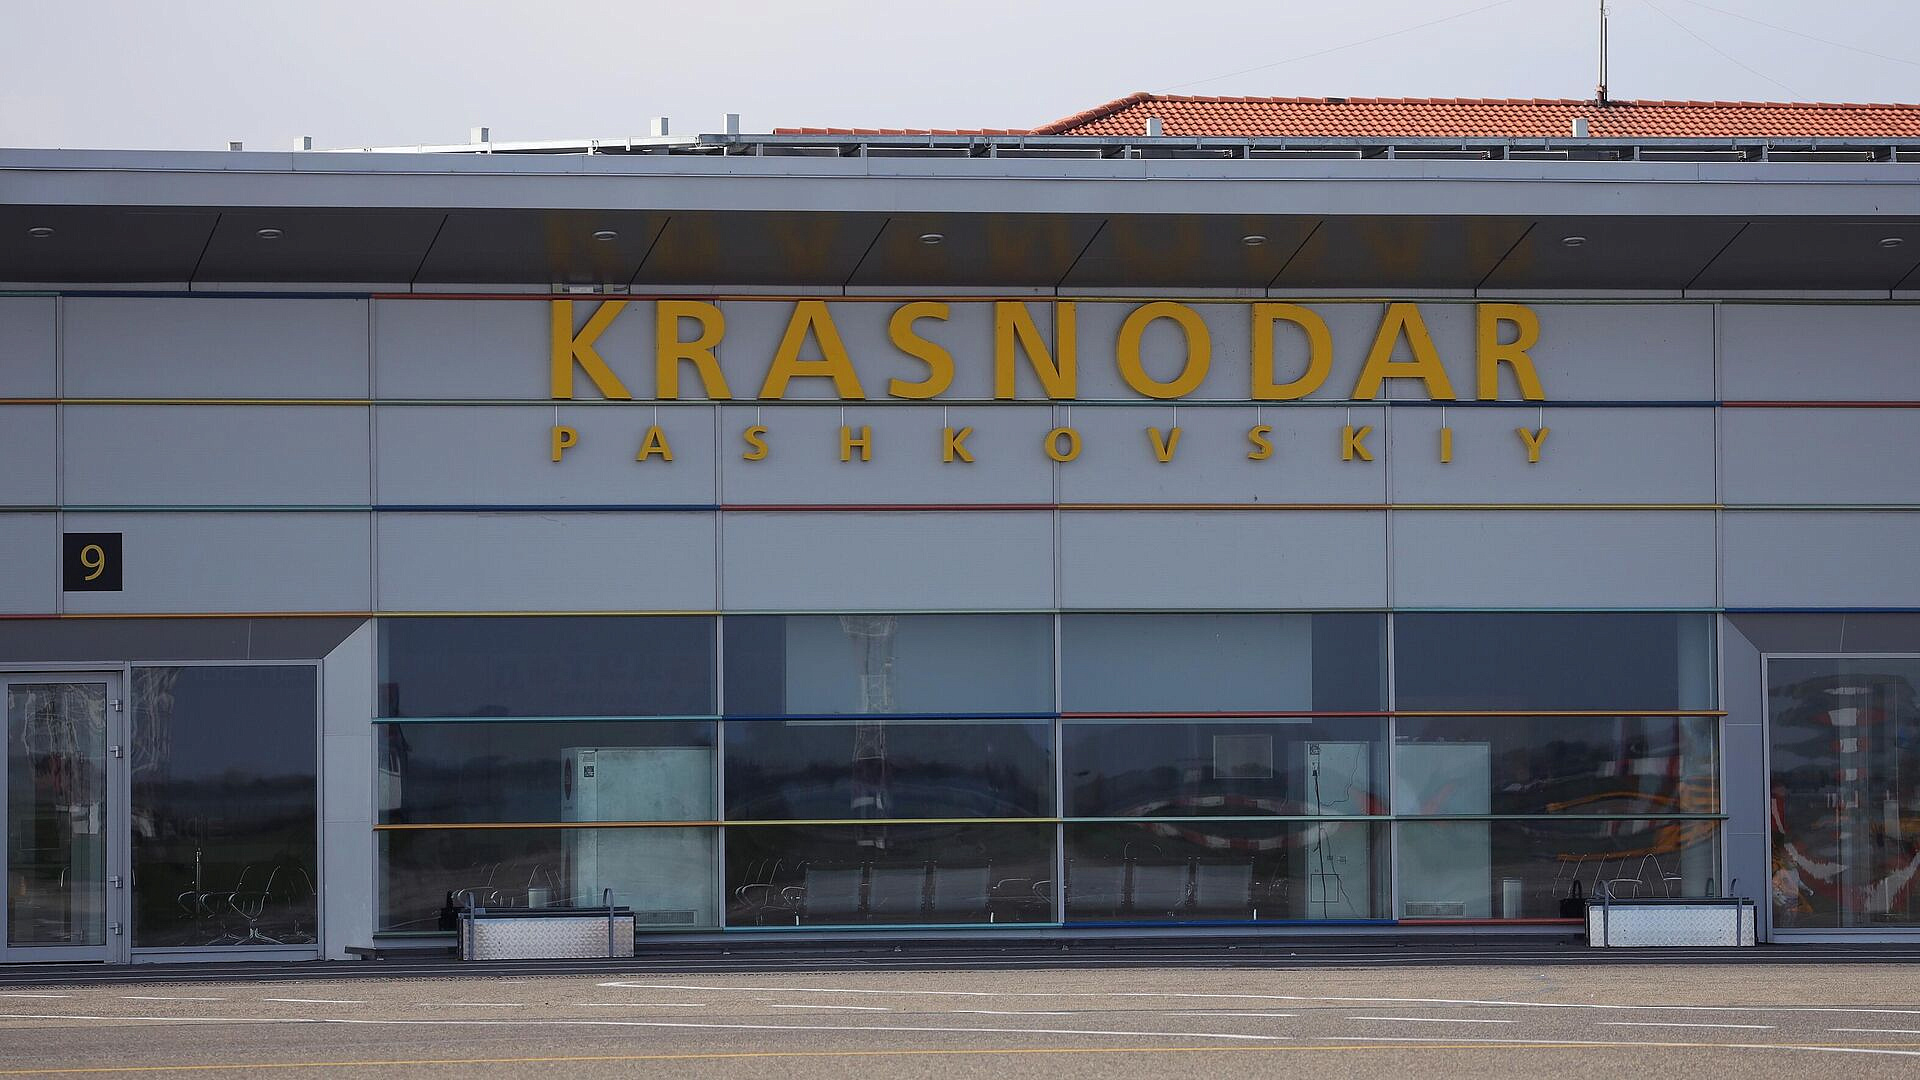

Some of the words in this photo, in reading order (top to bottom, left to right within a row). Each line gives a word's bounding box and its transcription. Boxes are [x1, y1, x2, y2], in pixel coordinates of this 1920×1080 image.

[551, 300, 1545, 401] KRASNODAR
[552, 425, 1550, 463] PASHKOVSKIY
[81, 544, 105, 581] 9
